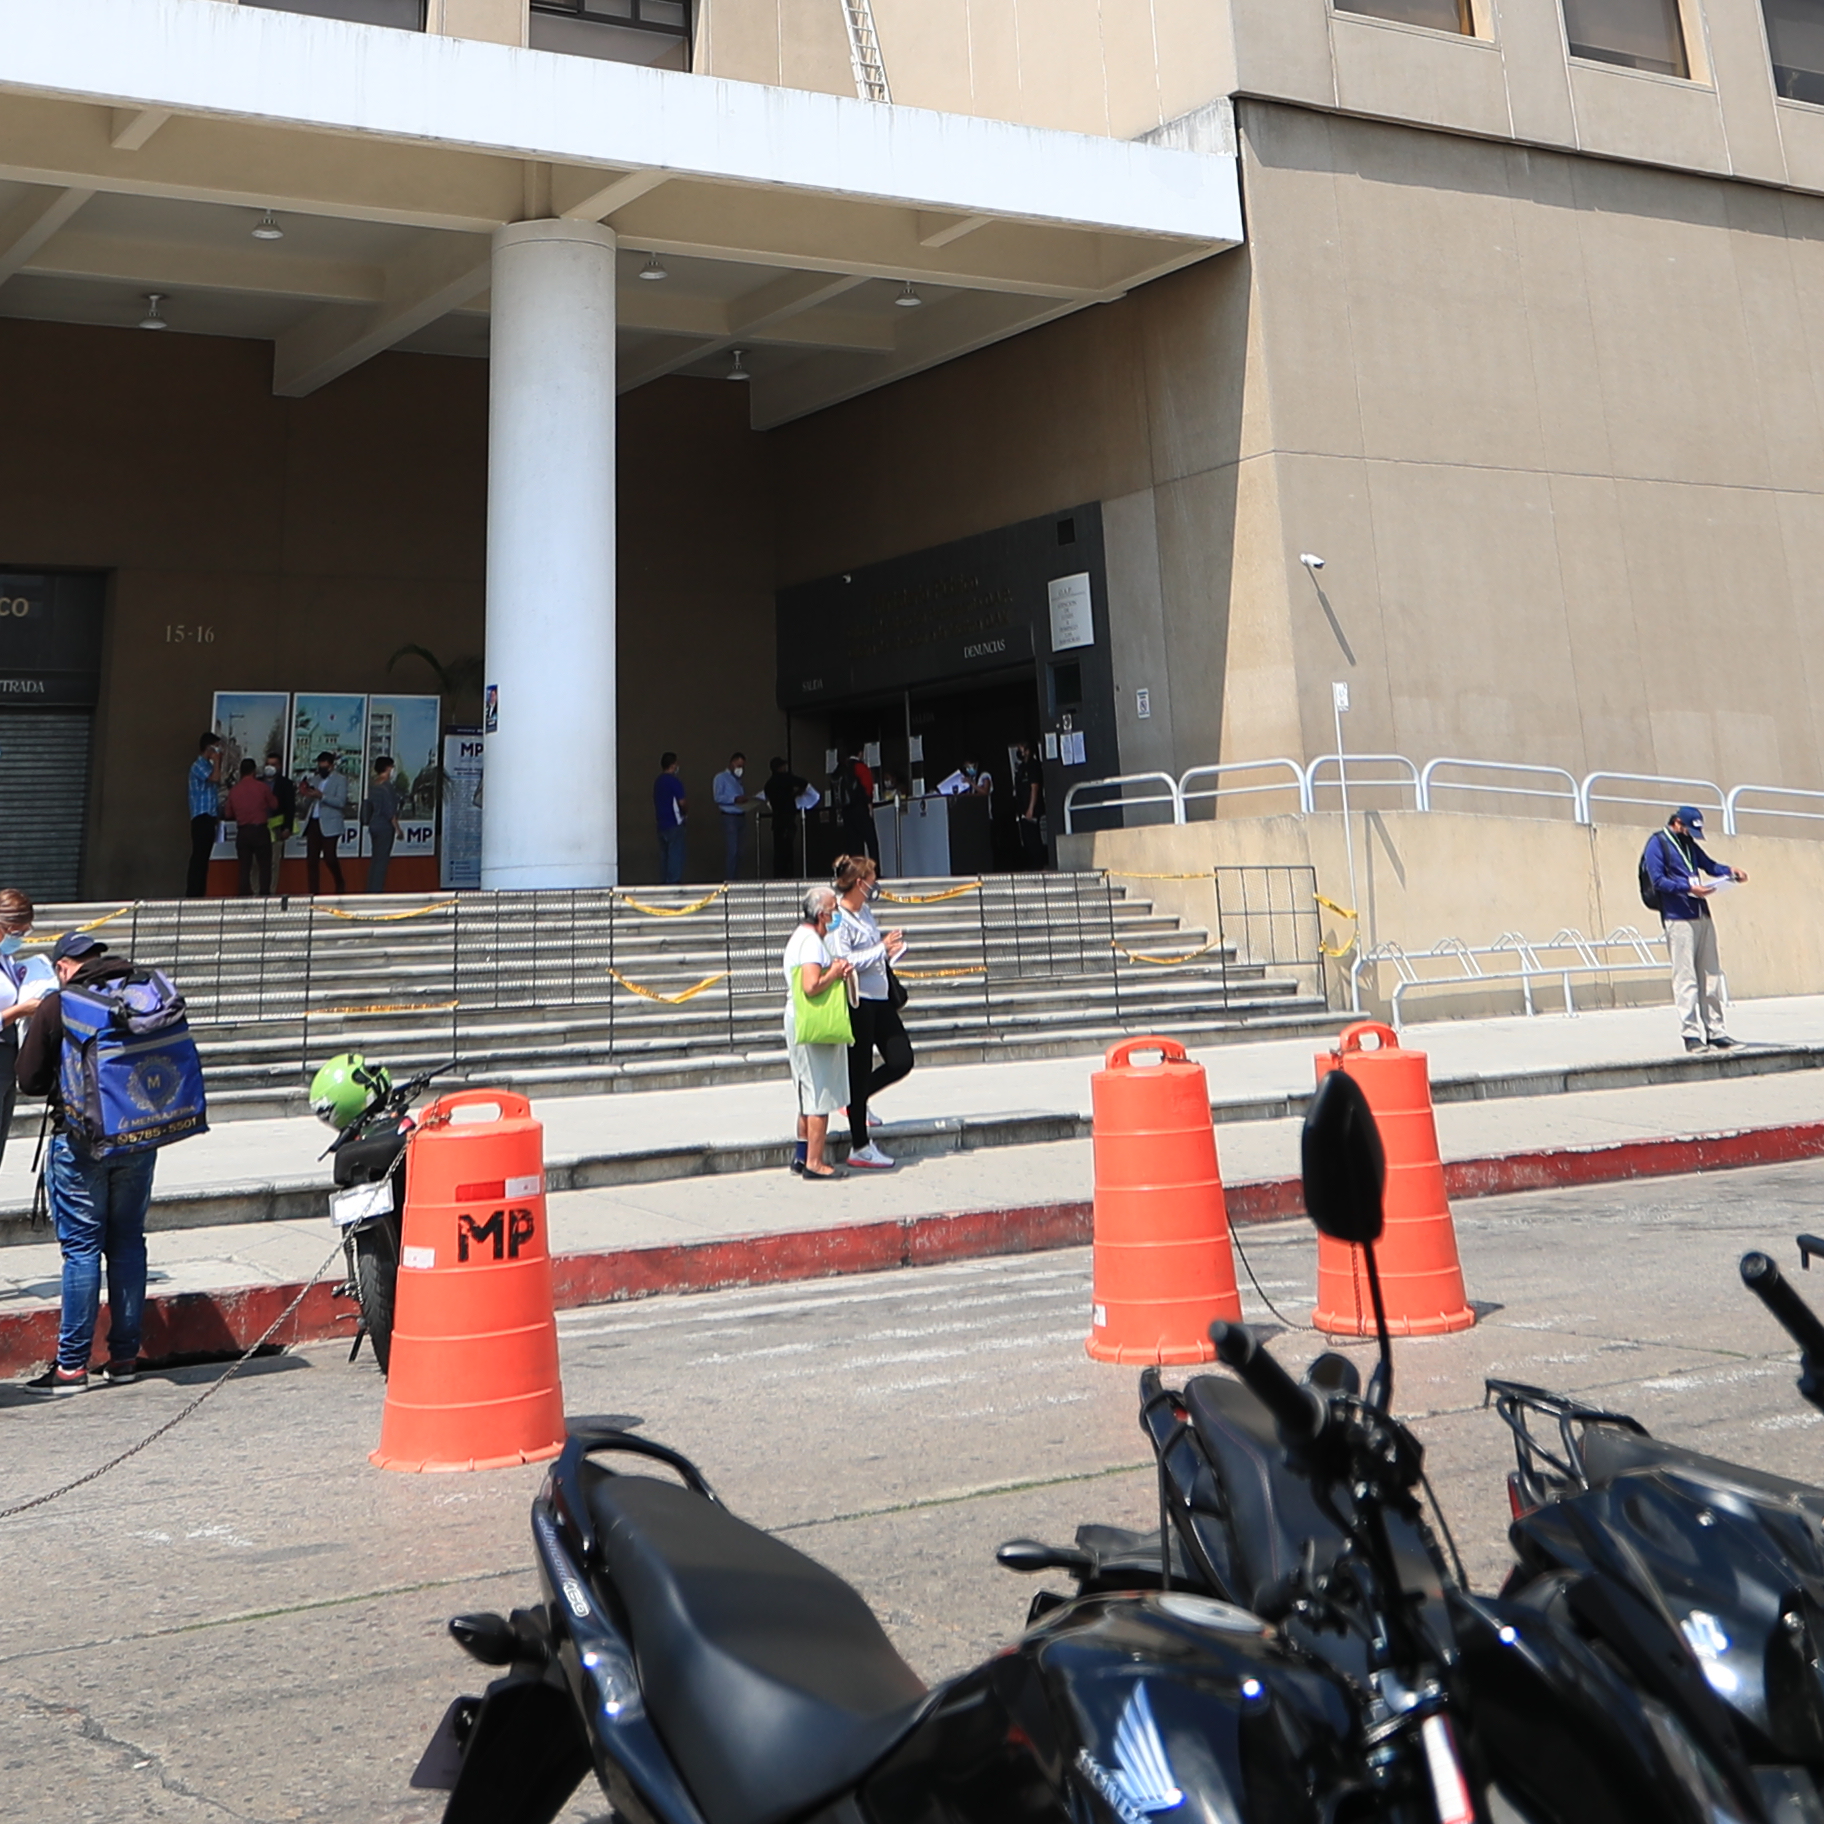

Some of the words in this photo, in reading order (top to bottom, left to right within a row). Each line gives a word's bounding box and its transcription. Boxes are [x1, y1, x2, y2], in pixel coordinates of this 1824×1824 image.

[165, 624, 215, 643] 15-16
[963, 638, 1007, 659] DENUNCIAS
[407, 827, 433, 844] MP
[457, 1208, 535, 1263] MP
